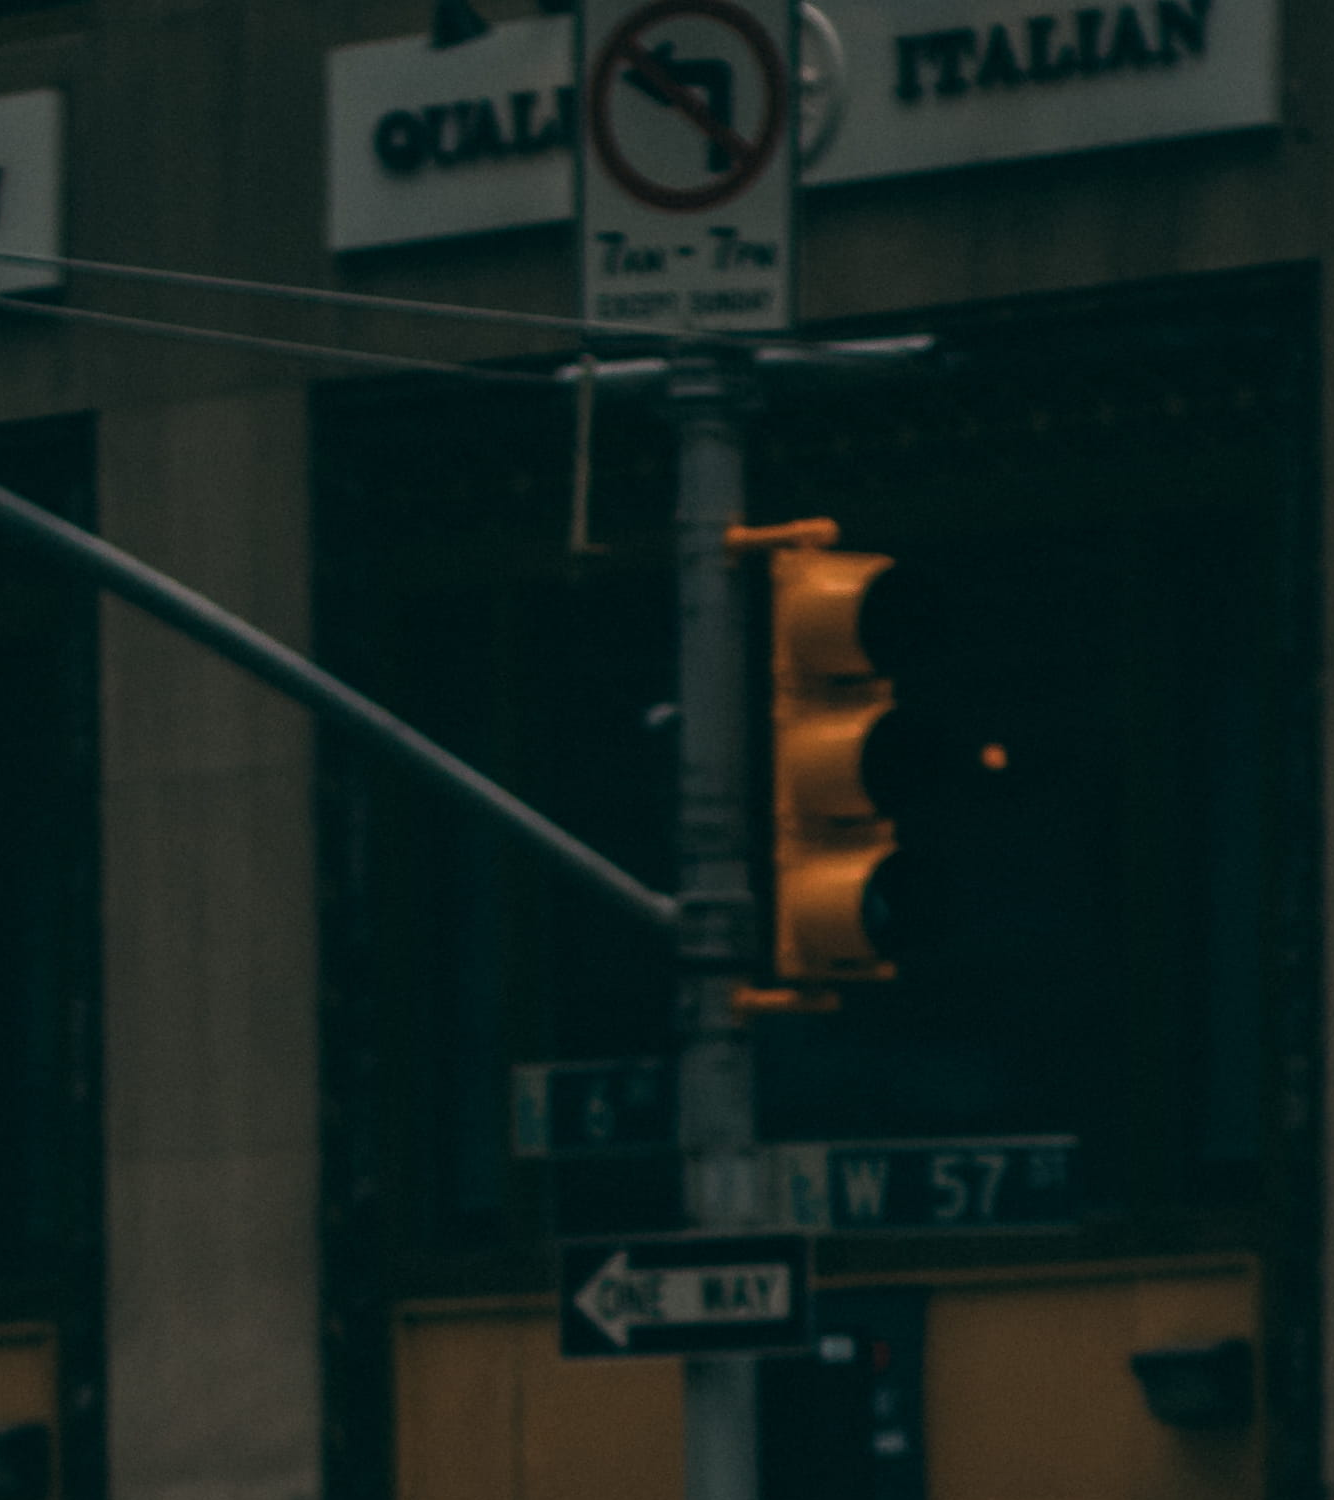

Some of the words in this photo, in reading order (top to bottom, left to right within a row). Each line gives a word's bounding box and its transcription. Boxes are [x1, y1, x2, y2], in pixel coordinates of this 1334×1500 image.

[893, 0, 1211, 105] ITALIAN
[842, 1158, 887, 1218] W
[930, 1152, 1007, 1220] 57
[595, 1276, 665, 1320] ONE
[701, 1272, 779, 1312] WAY
